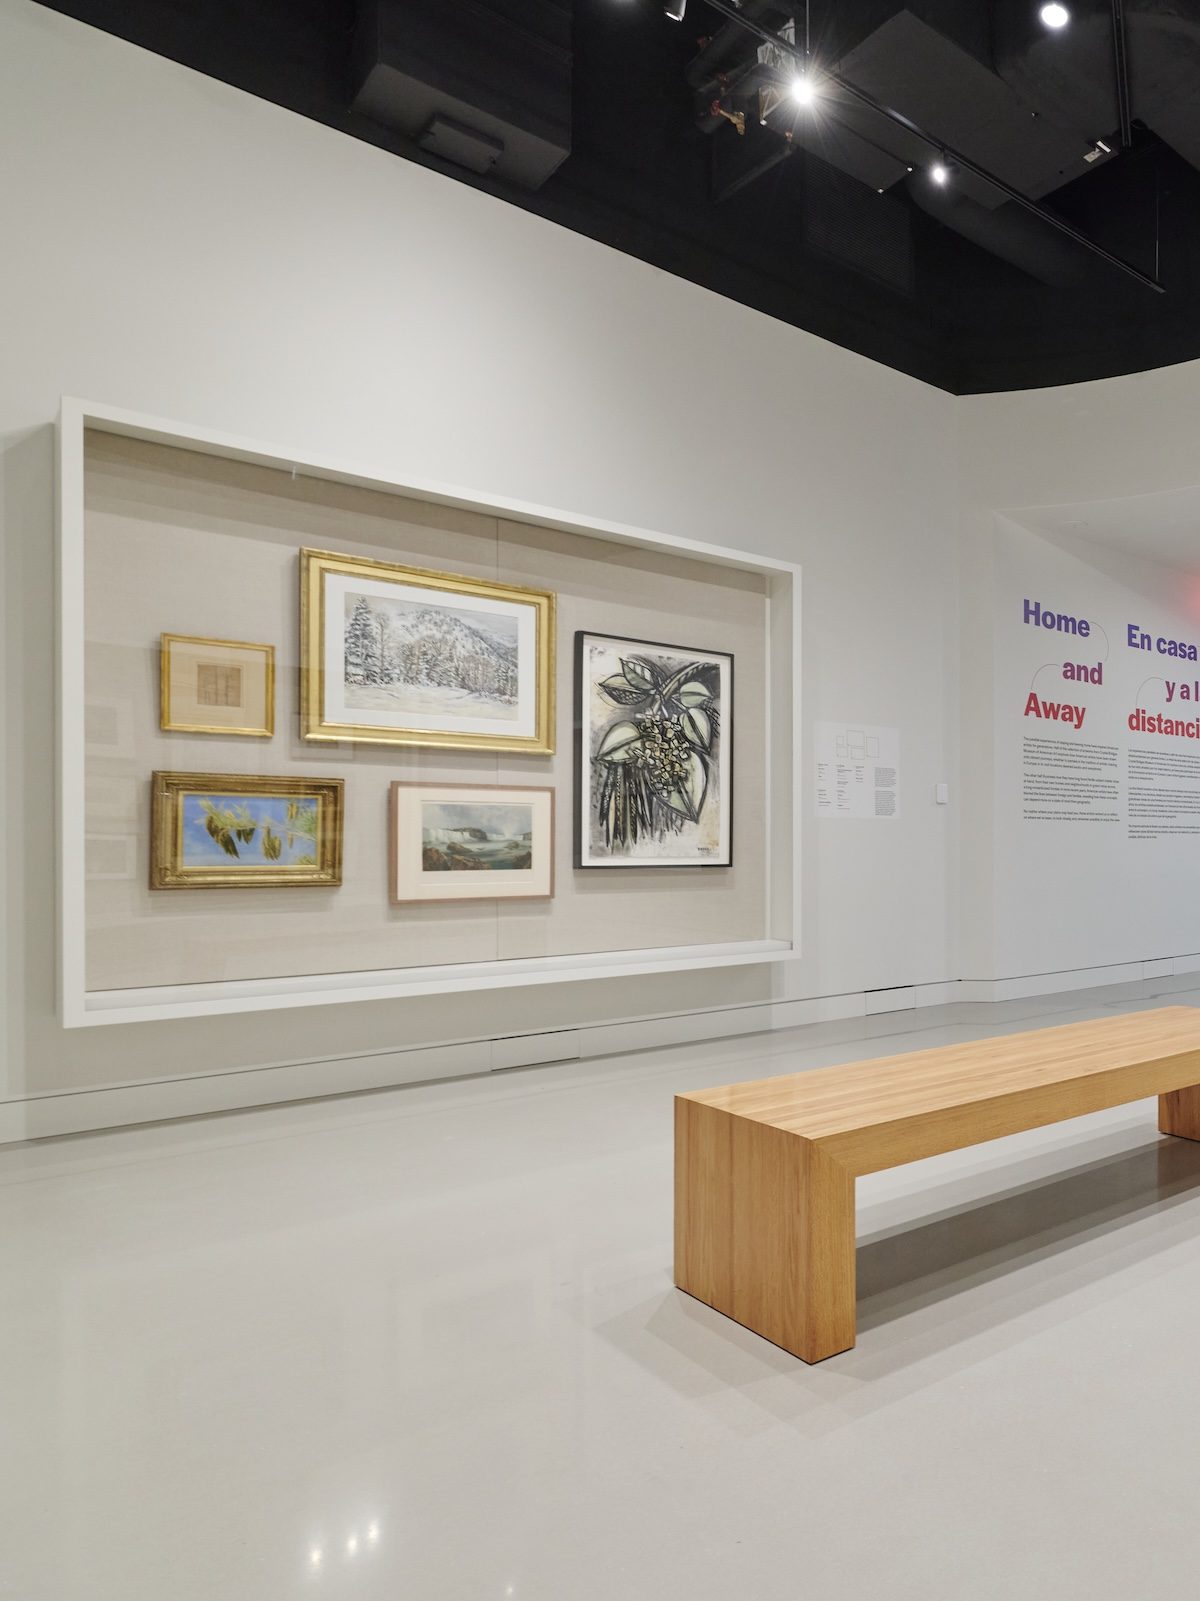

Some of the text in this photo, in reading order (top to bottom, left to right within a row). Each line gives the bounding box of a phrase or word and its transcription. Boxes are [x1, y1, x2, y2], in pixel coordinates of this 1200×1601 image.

[1023, 599, 1090, 638] Home
[1127, 623, 1198, 661] En casa
[1062, 662, 1103, 685] and
[1165, 680, 1176, 703] y
[1180, 683, 1190, 701] a
[1024, 692, 1086, 730] Away
